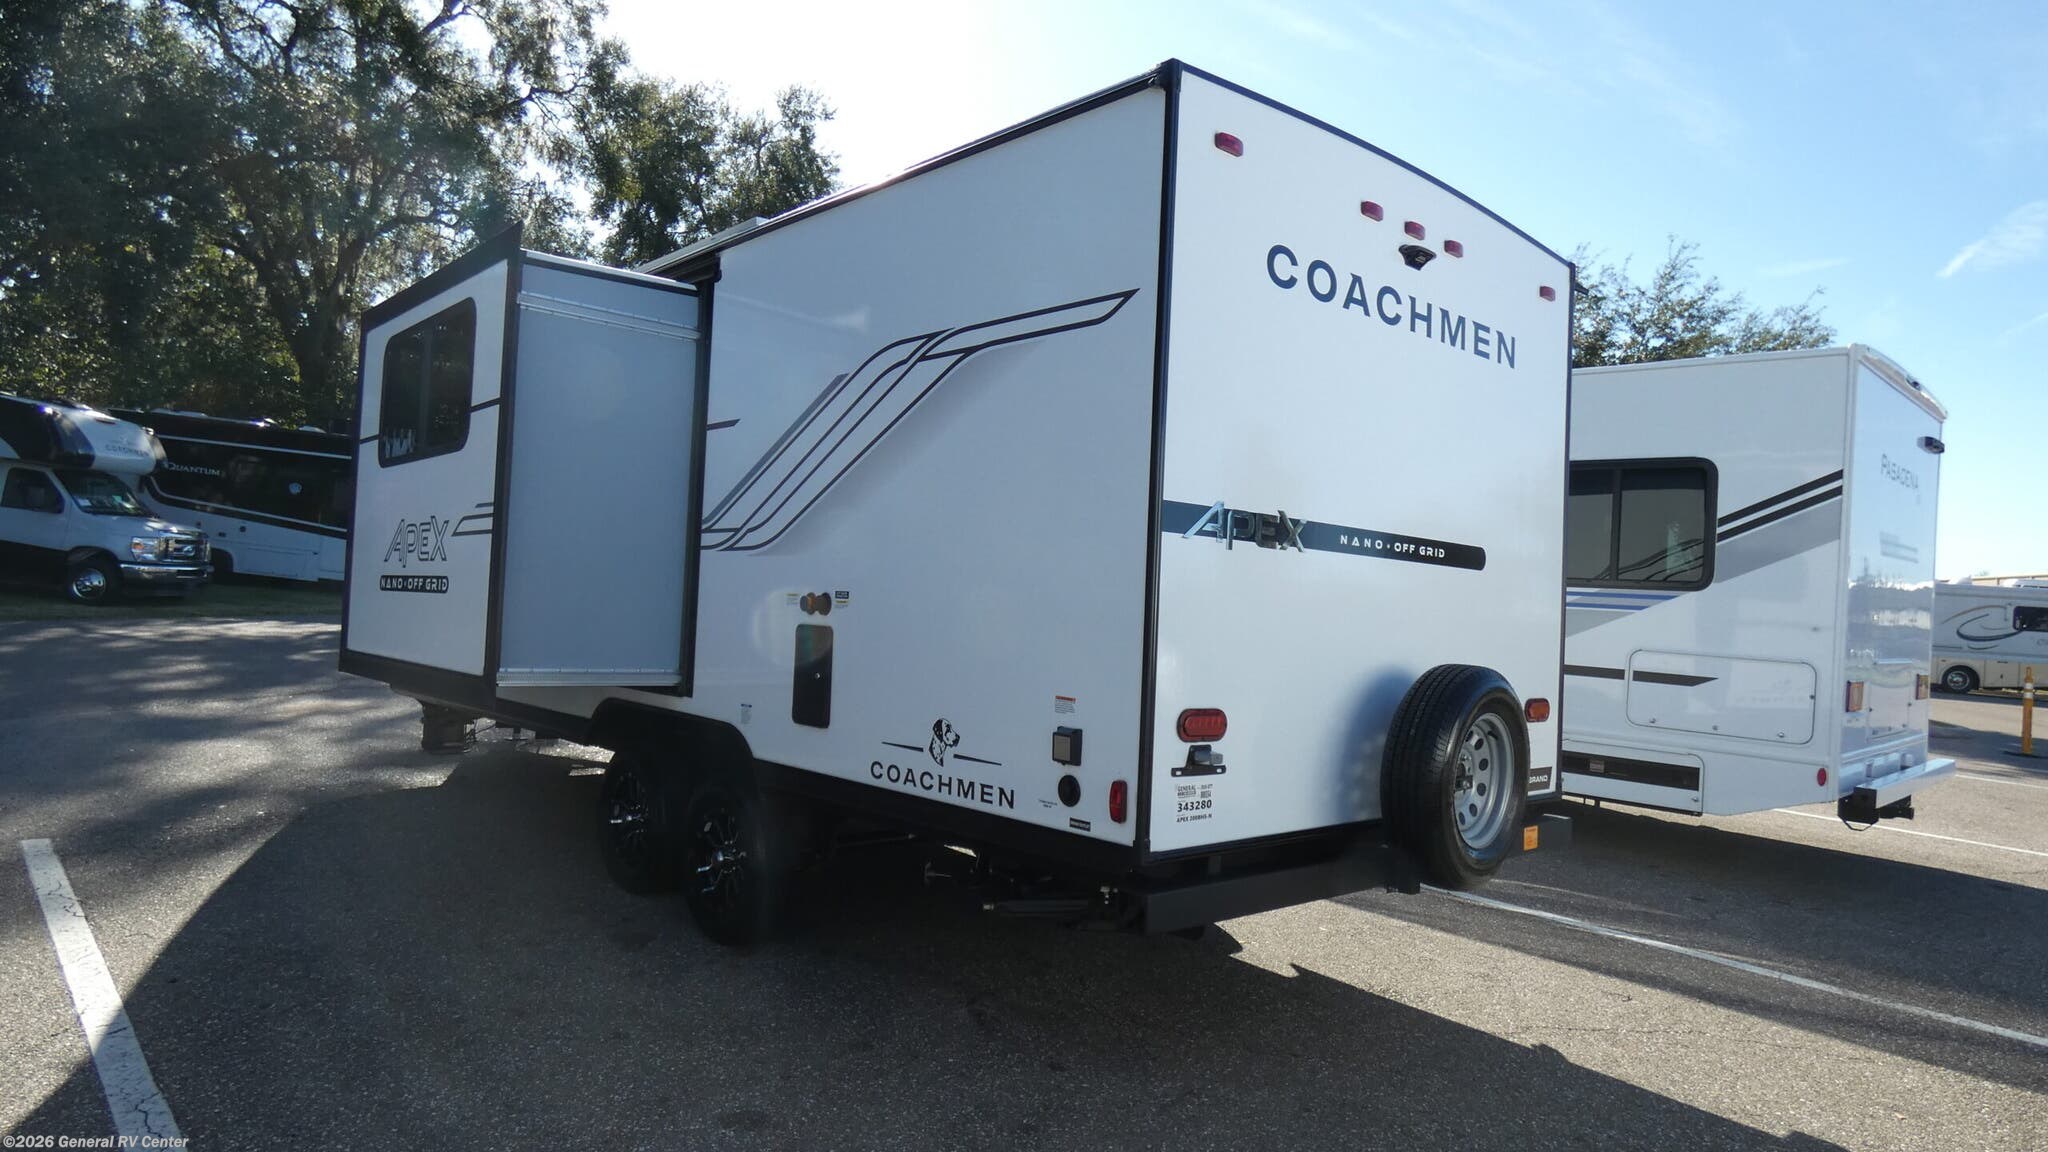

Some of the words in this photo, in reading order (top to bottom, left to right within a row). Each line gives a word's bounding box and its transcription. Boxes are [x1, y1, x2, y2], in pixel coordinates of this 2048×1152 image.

[1267, 244, 1516, 369] COACHMEN
[166, 461, 220, 476] QUANTUM
[384, 515, 449, 568] APEX
[1182, 500, 1307, 552] APEX
[1340, 534, 1383, 549] NANO
[1394, 542, 1415, 554] OFF
[1419, 546, 1445, 558] GRID
[381, 578, 403, 589] NANO
[407, 578, 423, 590] OFF
[425, 579, 448, 591] GRID
[870, 760, 1015, 809] COACHMEN
[1177, 799, 1212, 813] 343280
